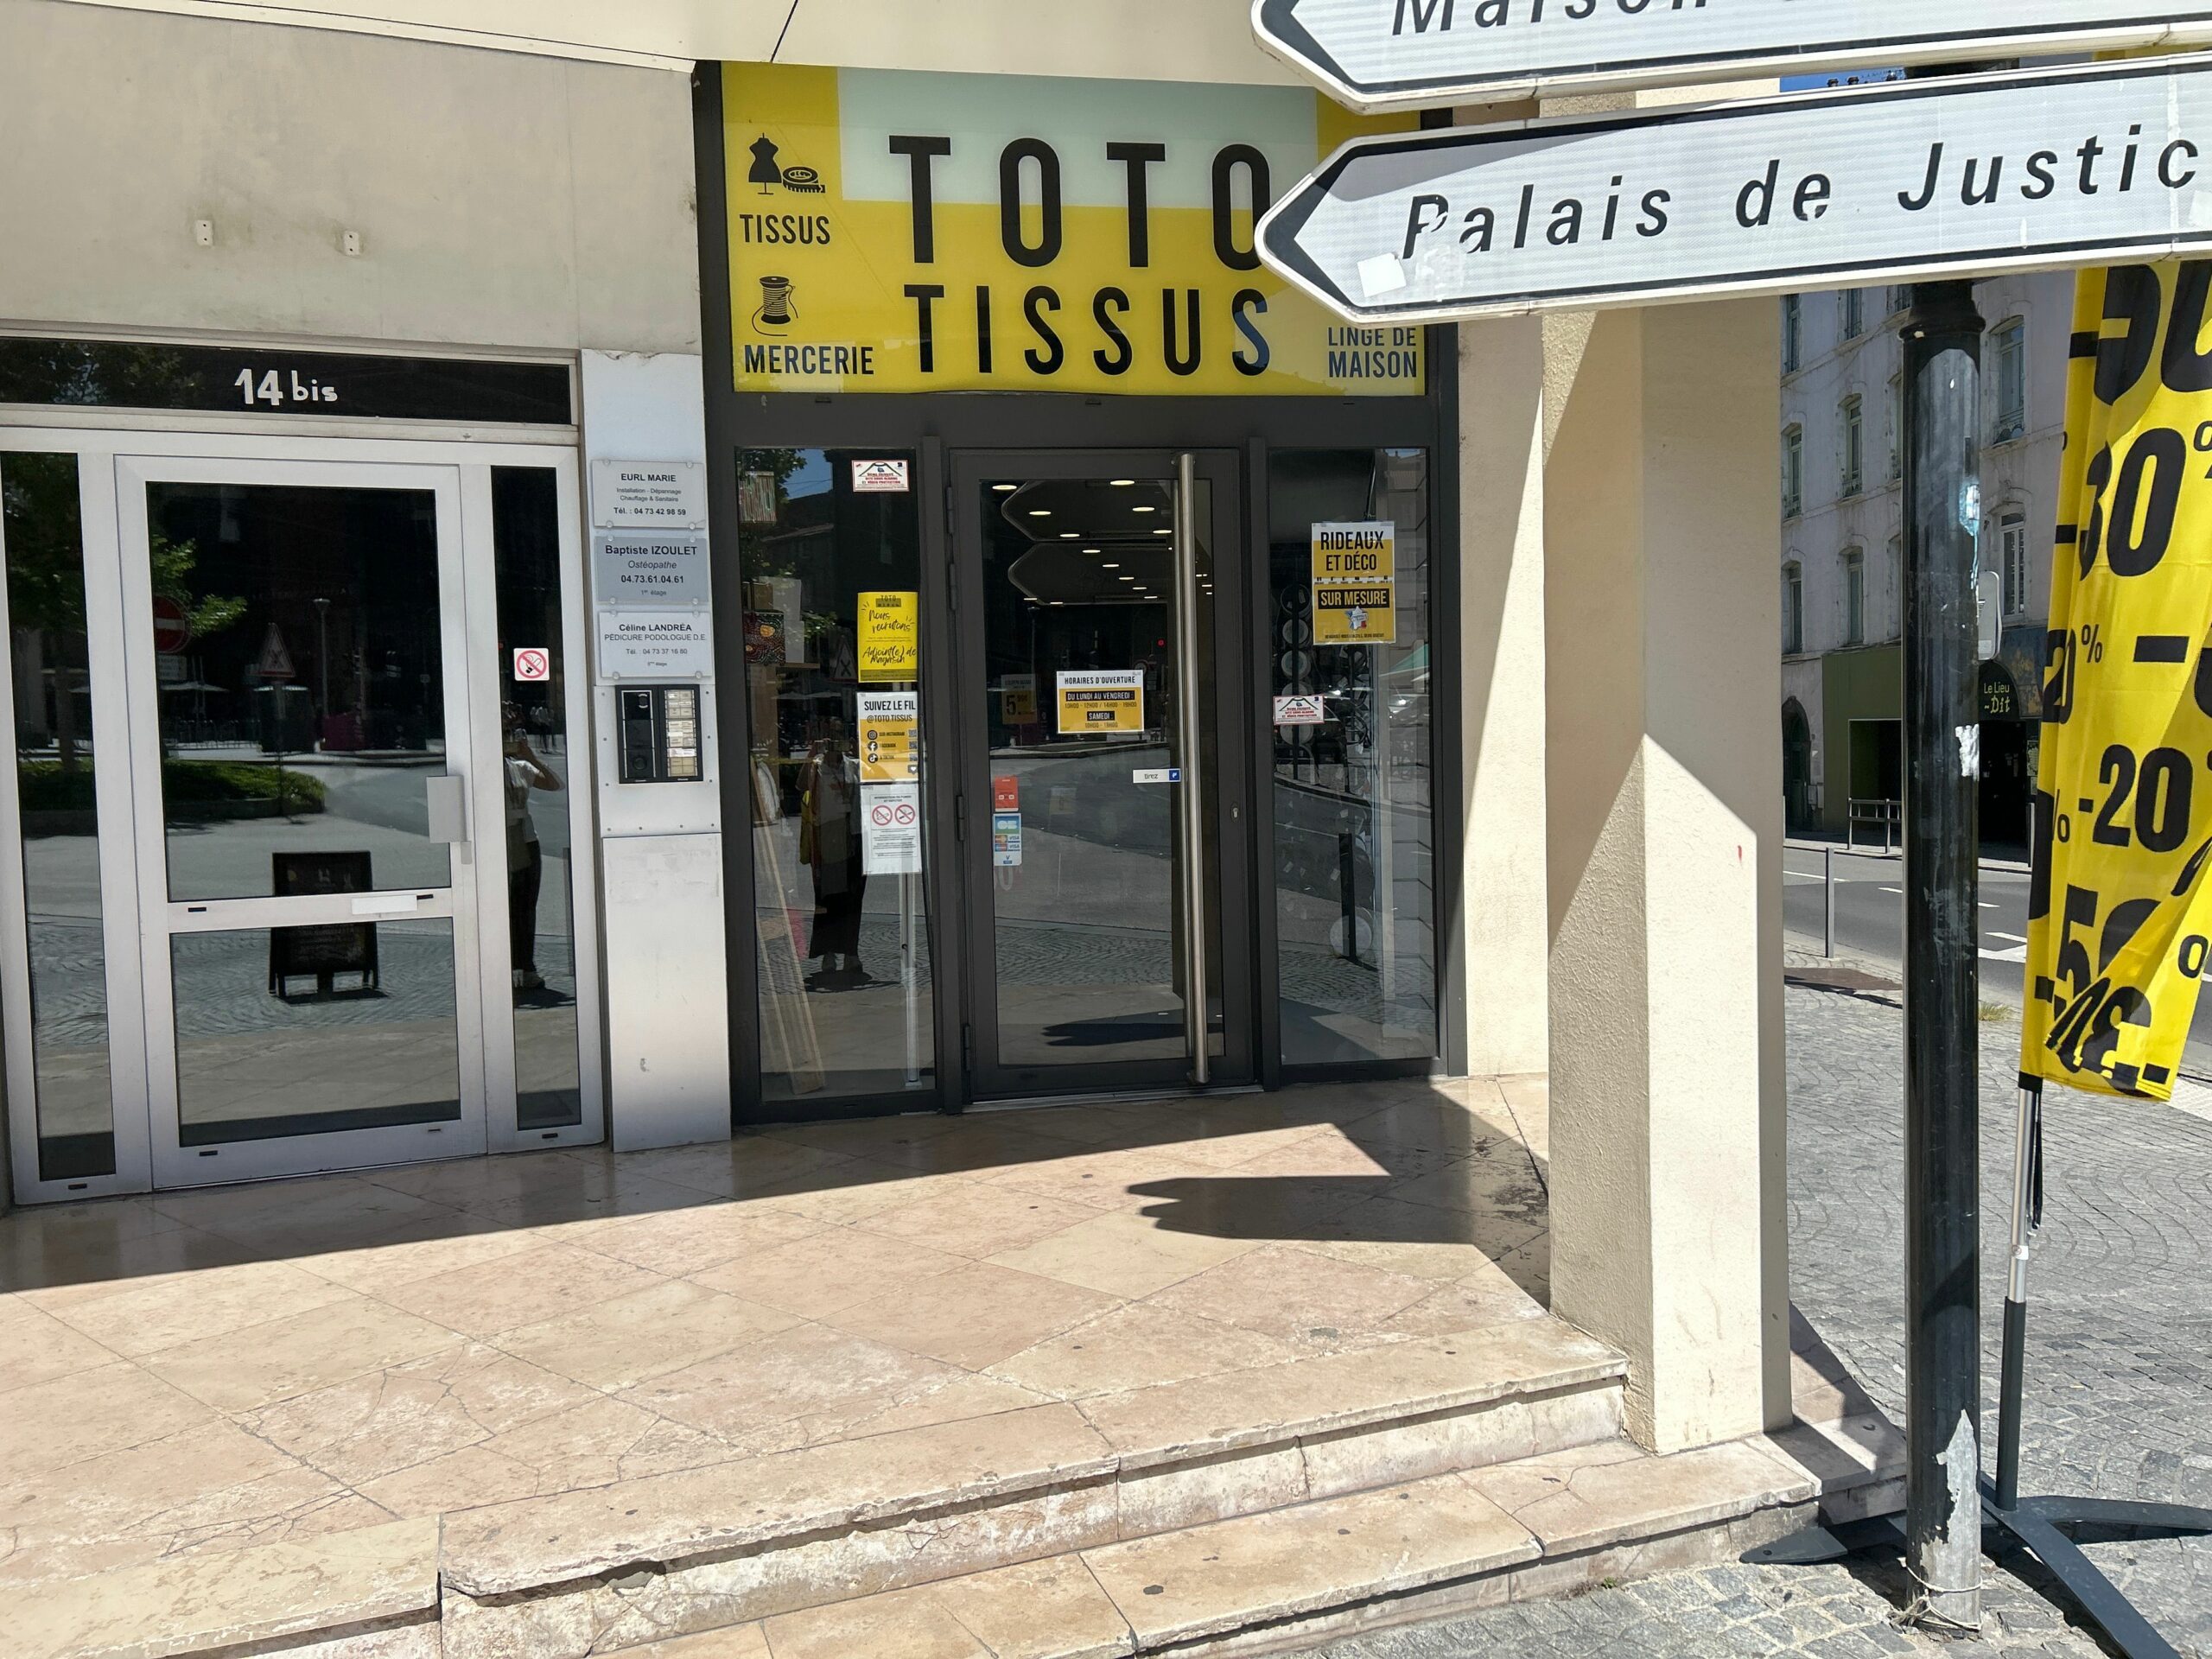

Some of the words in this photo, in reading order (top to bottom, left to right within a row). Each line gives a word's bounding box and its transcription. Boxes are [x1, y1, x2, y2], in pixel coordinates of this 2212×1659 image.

[1401, 174, 1671, 260] Palais
[1736, 159, 1831, 227] de
[1897, 124, 2199, 213] Justic
[888, 134, 1271, 271] TOTO
[739, 213, 831, 246] TISSUS
[904, 283, 1268, 377] TISSUS
[1328, 327, 1385, 346] LINGE
[1392, 327, 1417, 346] DE
[744, 344, 874, 375] MERCERIE
[1328, 351, 1417, 378] MAISON
[234, 368, 283, 406] 14
[291, 370, 338, 402] bis
[620, 473, 645, 481] EURL
[1320, 531, 1384, 550] RIDEAUX
[605, 545, 649, 556] Baptiste
[651, 546, 697, 556] IZOULET
[627, 560, 677, 570] Ostéopathe
[1326, 555, 1341, 571] ET
[1344, 551, 1376, 570] DÉCO
[620, 575, 684, 583] 04.73.61.04.61
[1320, 592, 1342, 606] SUR
[1344, 590, 1387, 605] MESURE
[868, 609, 891, 621] Nous
[872, 619, 911, 633] recrutons
[1983, 683, 1993, 694] Le
[1993, 681, 2010, 693] Lieu
[864, 701, 892, 711] SUIVEZ
[893, 701, 902, 710] LE
[904, 701, 916, 710] FIL
[867, 715, 913, 723] @TOTO.TISSUS
